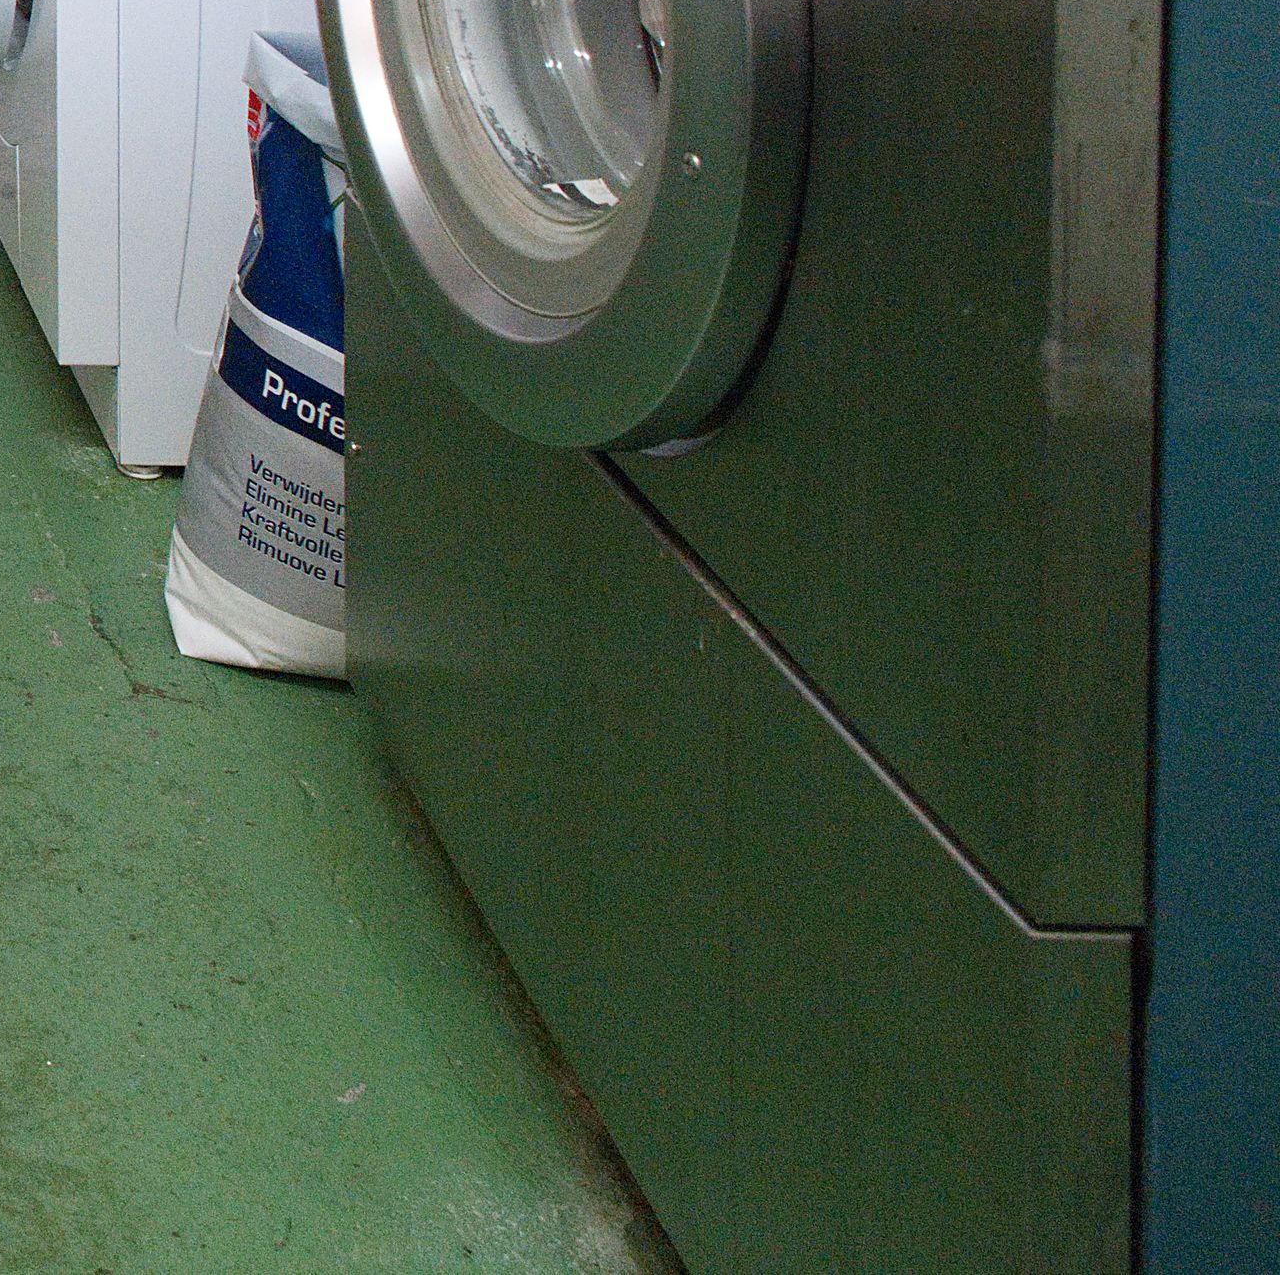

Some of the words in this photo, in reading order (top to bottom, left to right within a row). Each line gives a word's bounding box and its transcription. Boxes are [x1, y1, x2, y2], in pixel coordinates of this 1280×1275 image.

[262, 368, 346, 440] Profe
[241, 501, 343, 563] Kraftvolle
[245, 478, 317, 528] Elimine
[238, 524, 327, 581] Rimuove
